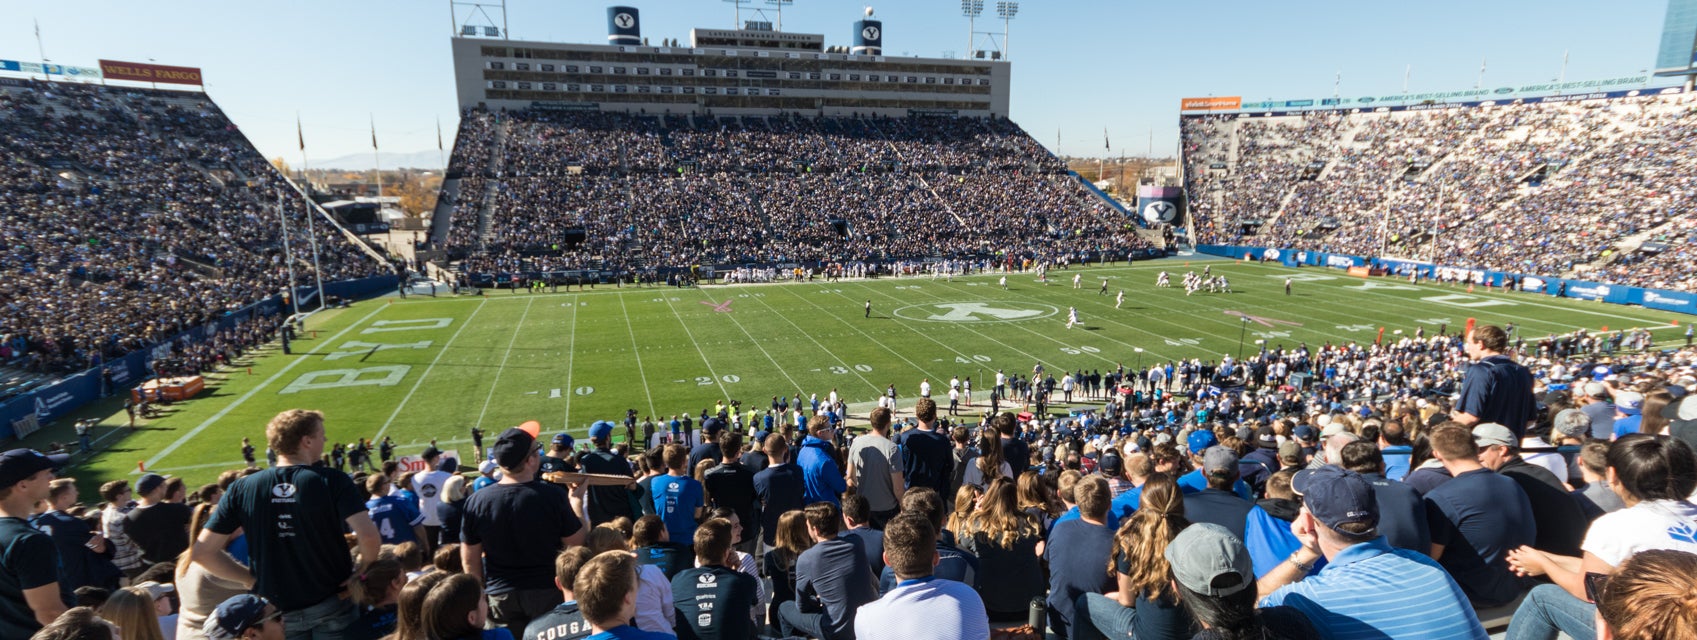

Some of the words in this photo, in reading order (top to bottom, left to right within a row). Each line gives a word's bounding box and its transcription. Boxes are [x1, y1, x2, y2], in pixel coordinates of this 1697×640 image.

[103, 65, 151, 78] WELLS
[155, 67, 200, 81] FARGO
[1519, 82, 1562, 93] AMERICA'S
[1561, 79, 1616, 90] BEST-SELLING
[1616, 75, 1647, 86] BRAND
[1379, 94, 1415, 102] AMERICA'S
[1415, 90, 1463, 100] BEST-SELLING
[1463, 89, 1490, 97] BRAND
[279, 317, 454, 395] BYU
[1059, 345, 1101, 355] 50
[954, 354, 993, 365] 40
[828, 363, 873, 375] 30
[694, 373, 741, 387] 20
[548, 385, 596, 399] 10
[380, 517, 395, 539] 4
